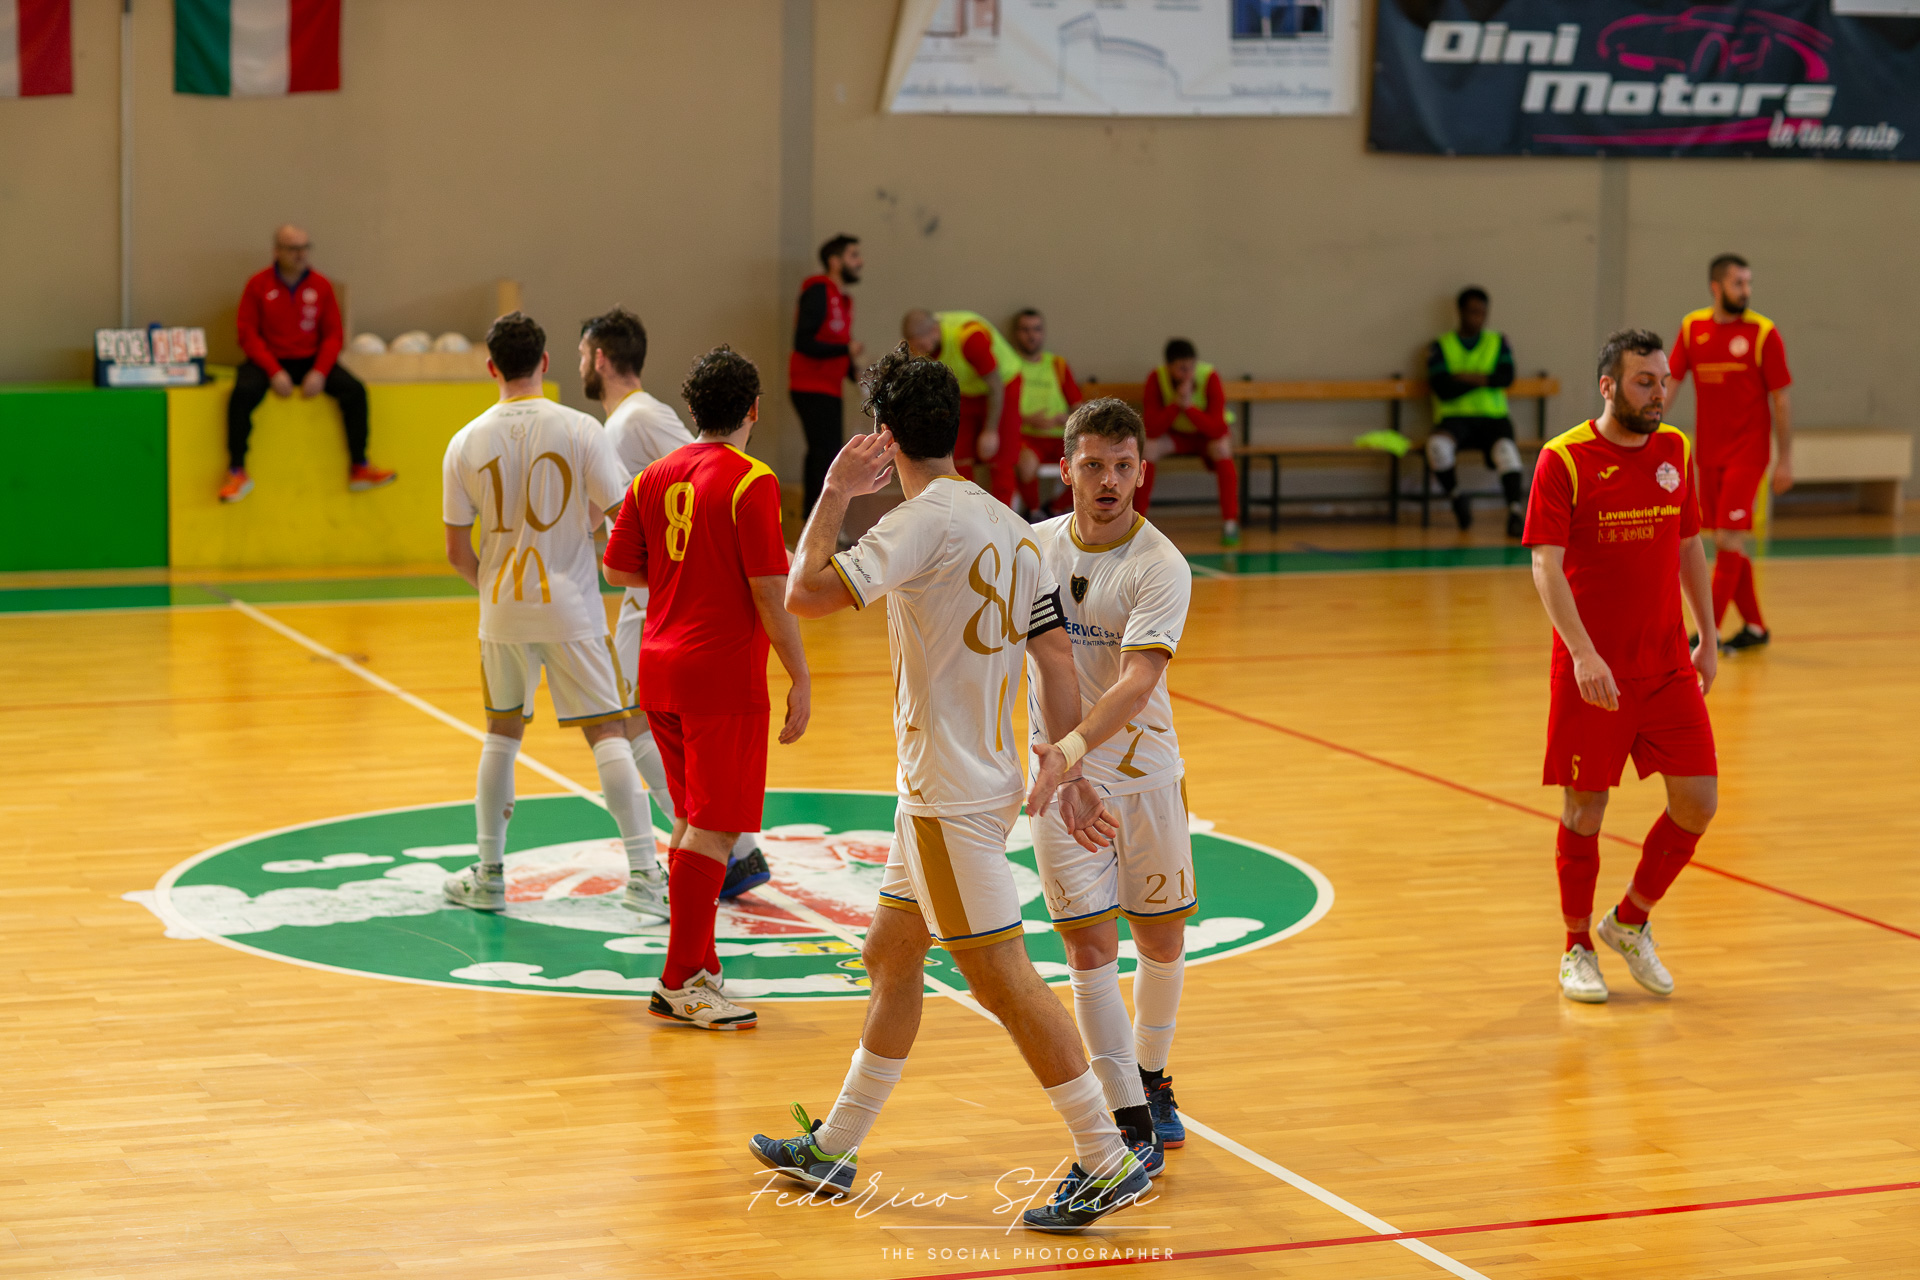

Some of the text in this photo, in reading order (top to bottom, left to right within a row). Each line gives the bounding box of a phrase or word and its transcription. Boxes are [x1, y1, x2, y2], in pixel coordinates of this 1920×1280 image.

[1422, 21, 1580, 65] Dini
[1521, 71, 1836, 117] Motors
[478, 452, 572, 533] 10
[665, 482, 695, 561] 8
[963, 538, 1042, 655] 80
[1571, 754, 1581, 781] 5
[1144, 867, 1188, 905] 21
